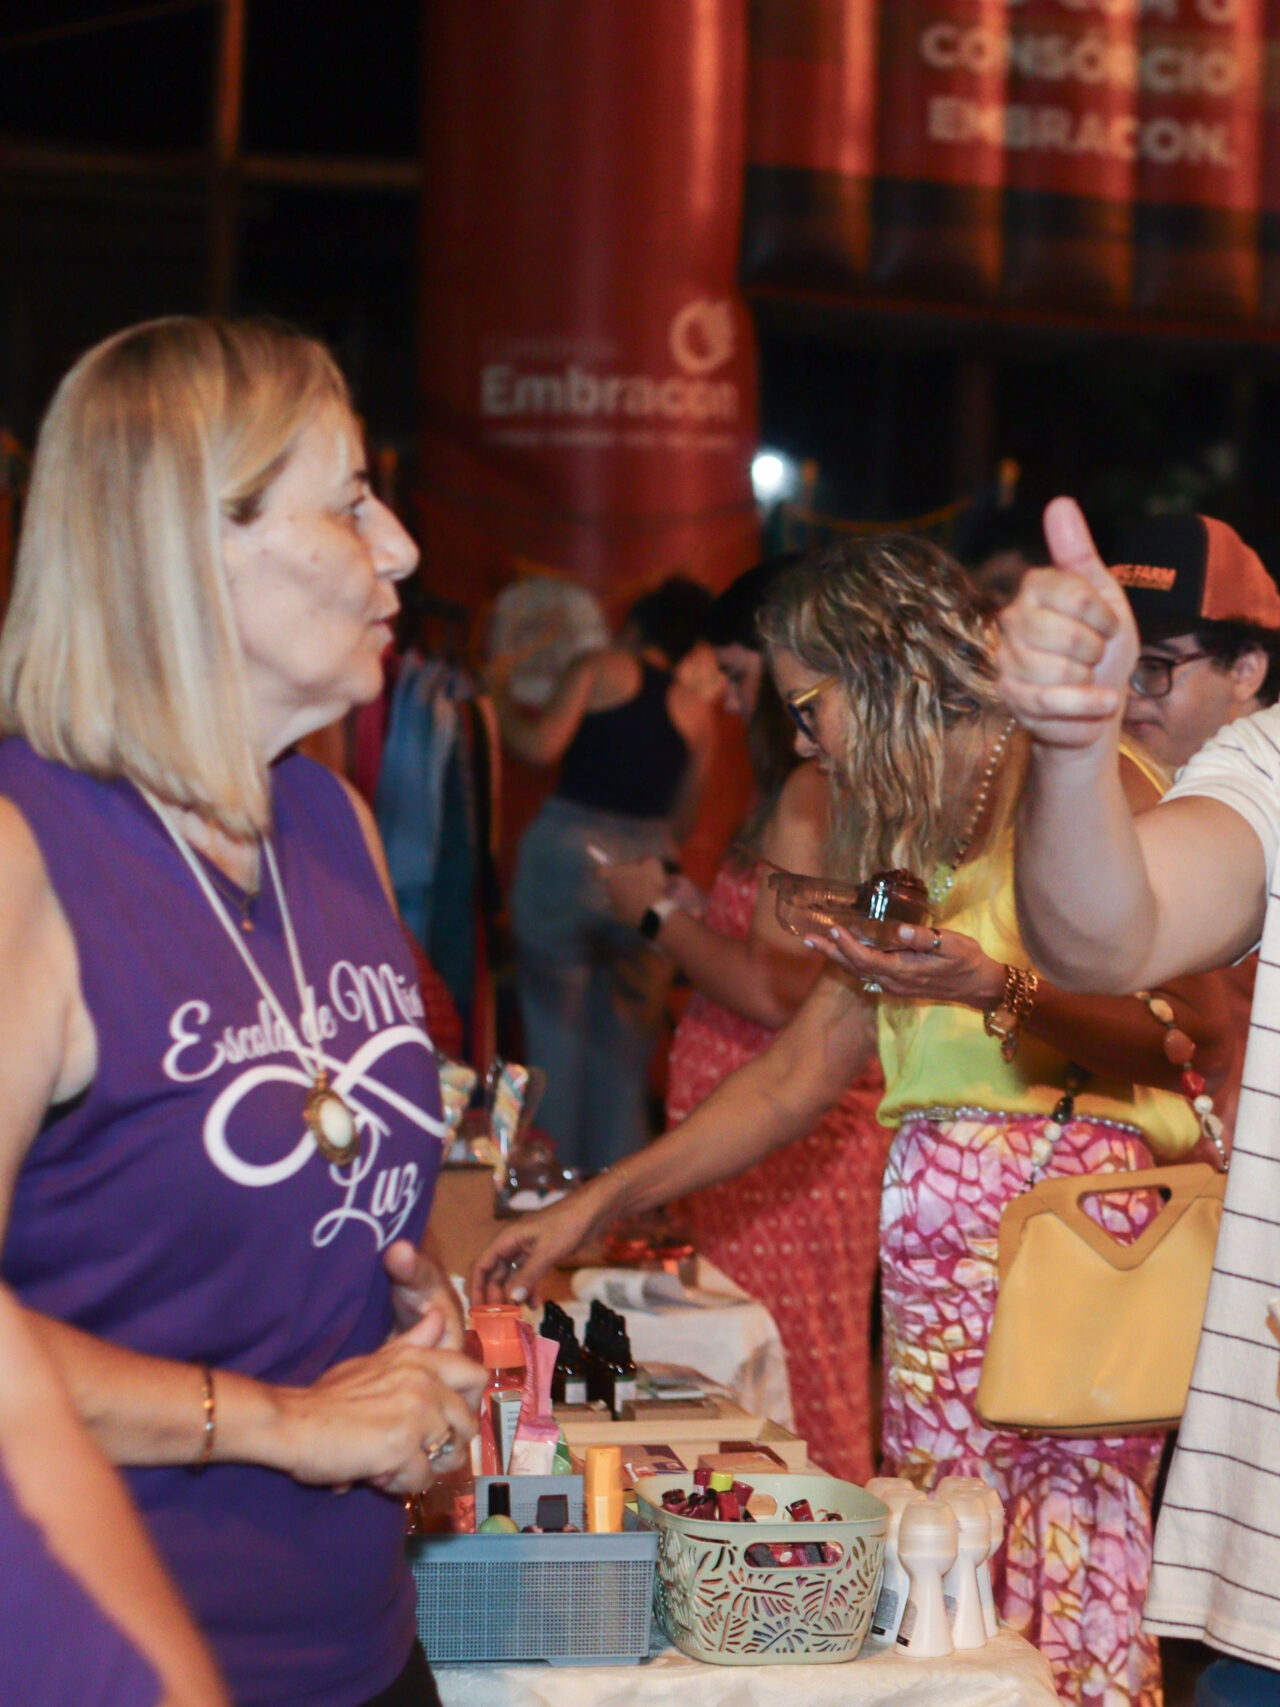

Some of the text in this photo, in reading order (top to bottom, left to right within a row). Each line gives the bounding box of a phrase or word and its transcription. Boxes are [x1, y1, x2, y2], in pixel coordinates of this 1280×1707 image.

[920, 22, 1242, 98] CONSÓRCIO
[480, 363, 740, 423] Embracon
[312, 1114, 424, 1252] Luz
